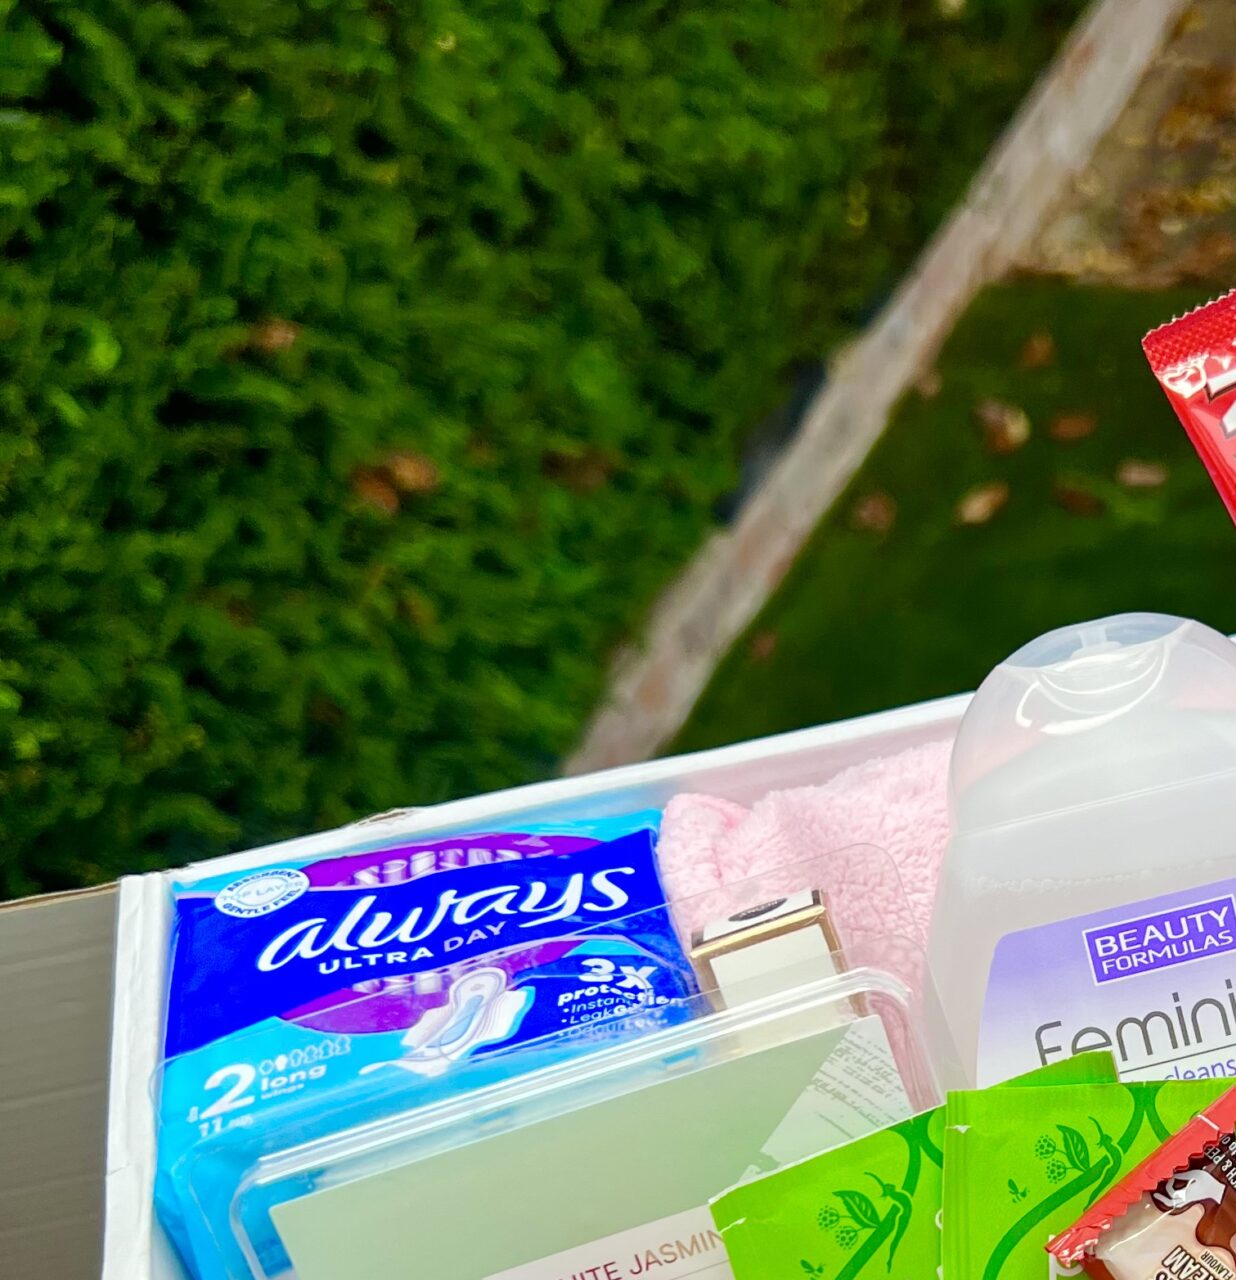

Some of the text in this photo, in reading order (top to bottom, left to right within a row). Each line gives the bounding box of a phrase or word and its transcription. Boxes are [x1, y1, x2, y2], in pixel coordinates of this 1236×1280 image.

[256, 866, 635, 972] always
[1095, 906, 1230, 958] BEAUTY
[319, 921, 507, 974] ULTRA DAY
[1101, 930, 1234, 975] FORMULAS
[200, 1063, 327, 1120] 2 long
[630, 1229, 723, 1276] JASMIN
